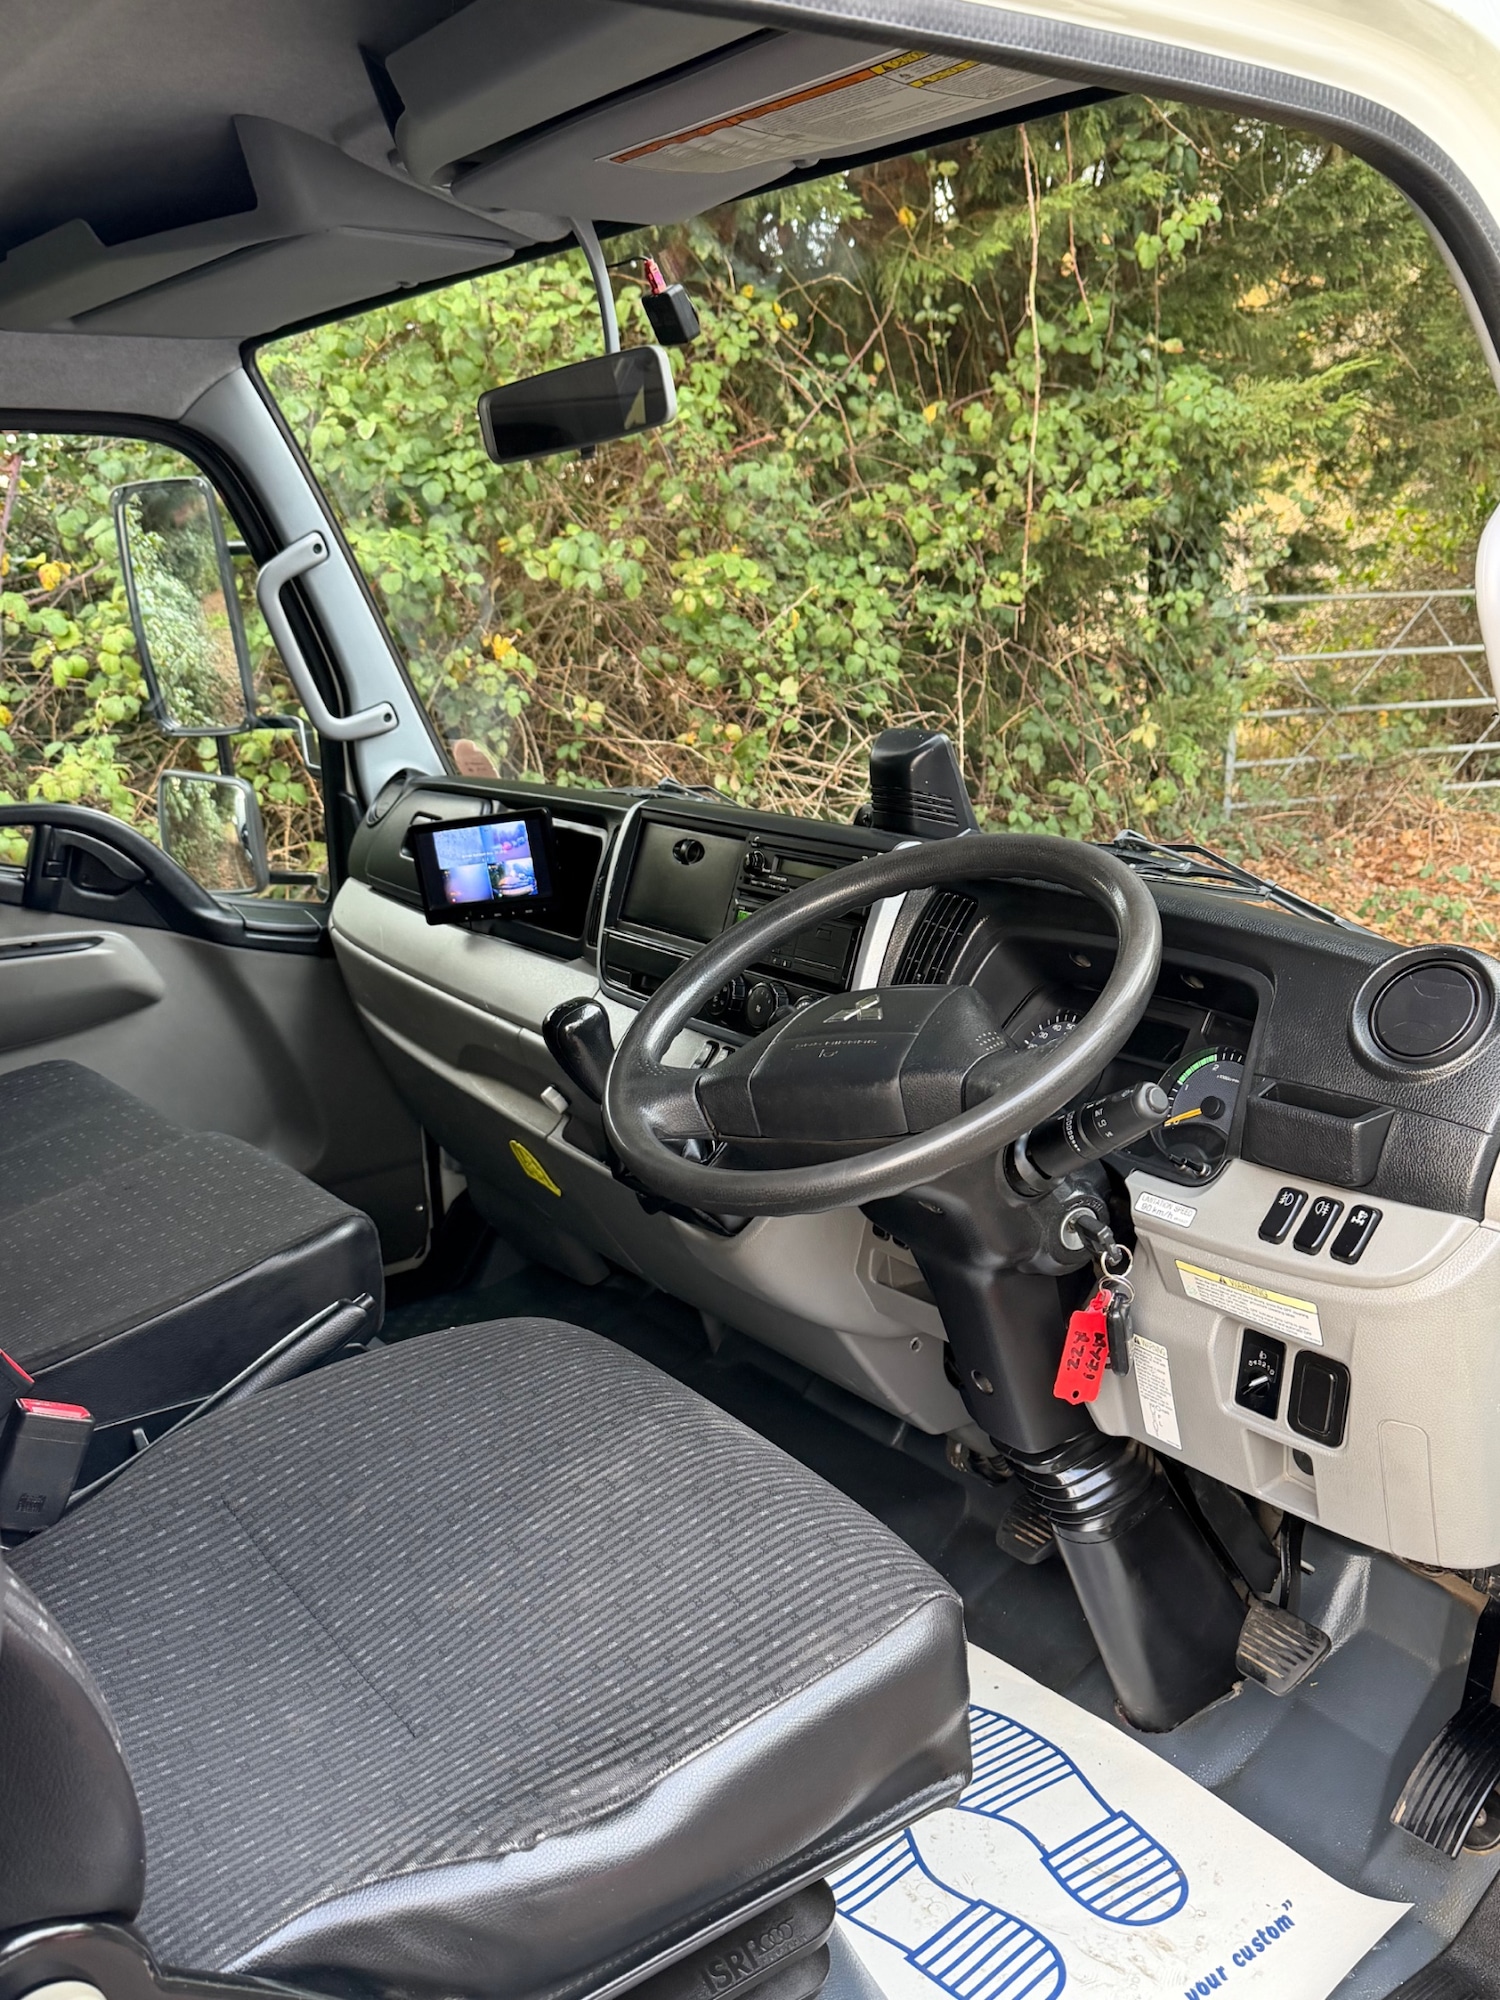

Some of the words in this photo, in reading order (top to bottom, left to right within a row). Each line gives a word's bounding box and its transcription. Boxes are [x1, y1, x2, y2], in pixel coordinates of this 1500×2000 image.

[1039, 1031, 1048, 1039] 30
[1141, 1194, 1173, 1210] LIMITATION
[1173, 1205, 1193, 1217] SPEED
[1141, 1202, 1152, 1212] 90
[1152, 1206, 1174, 1220] km/h
[1230, 1279, 1269, 1299] WARNING
